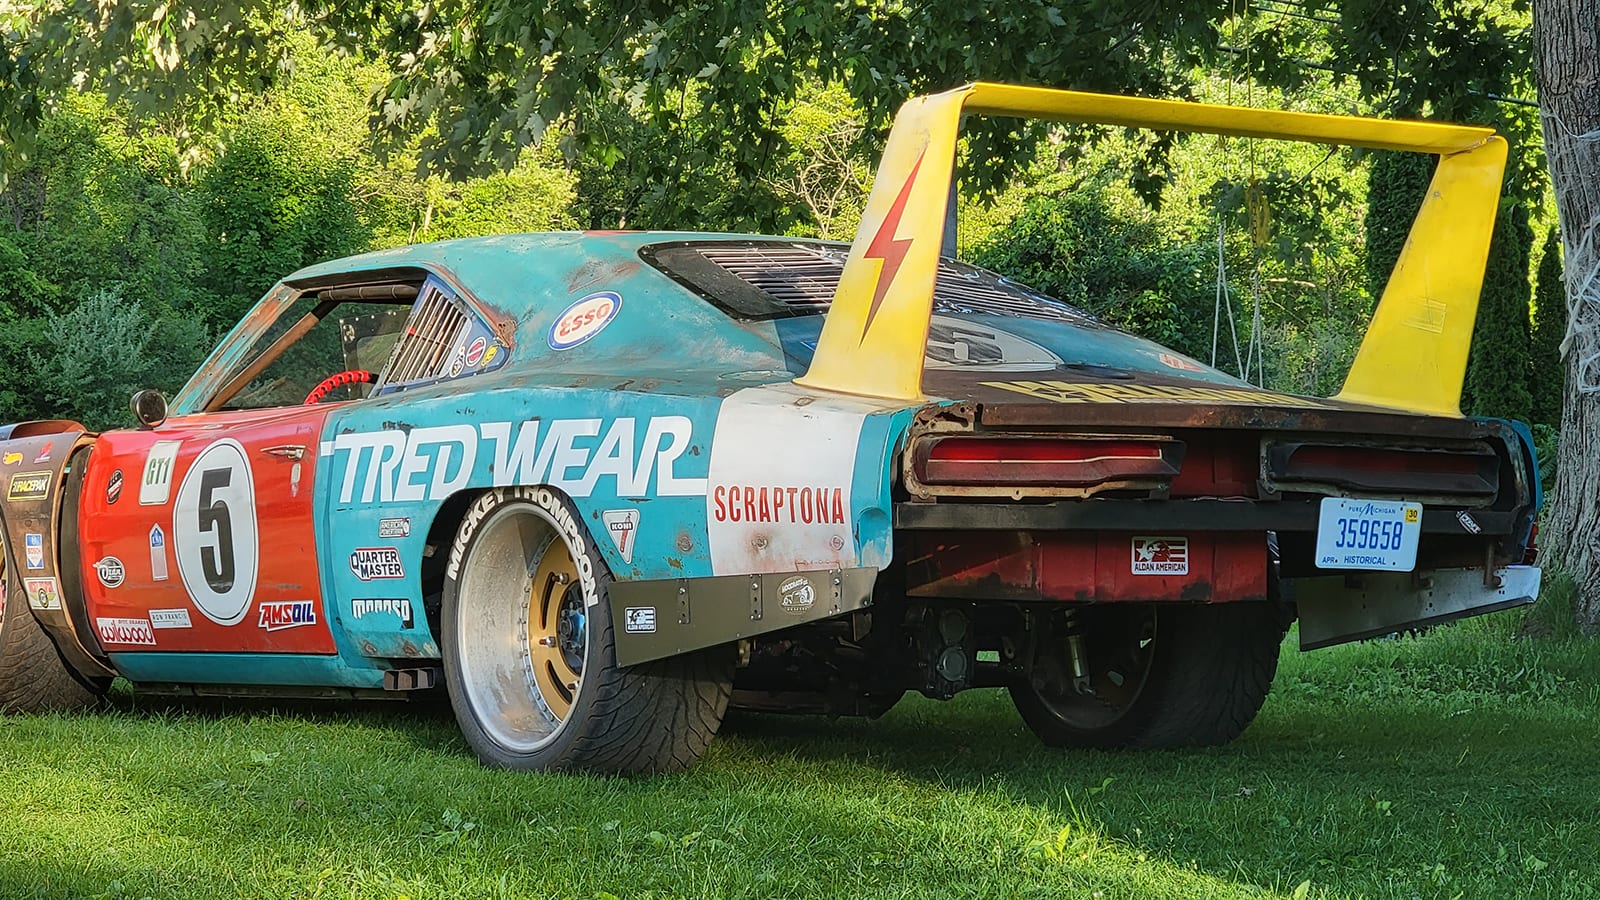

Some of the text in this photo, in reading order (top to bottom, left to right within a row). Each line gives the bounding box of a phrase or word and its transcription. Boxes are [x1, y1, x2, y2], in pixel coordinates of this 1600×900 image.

[146, 457, 171, 486] GT1
[320, 416, 710, 504] TRED WEAR
[714, 485, 845, 525] SCRAPTONA
[1409, 509, 1418, 518] 30
[199, 467, 235, 595] 5
[1335, 518, 1404, 551] 359658
[448, 485, 599, 608] MICKEY THOMPSON
[350, 551, 398, 570] QUARTER
[360, 563, 402, 578] MASTER
[1135, 562, 1186, 572] ALDAN AMERICAN
[1322, 555, 1387, 566] APR HISTORICAL
[261, 603, 315, 624] AMSOIL
